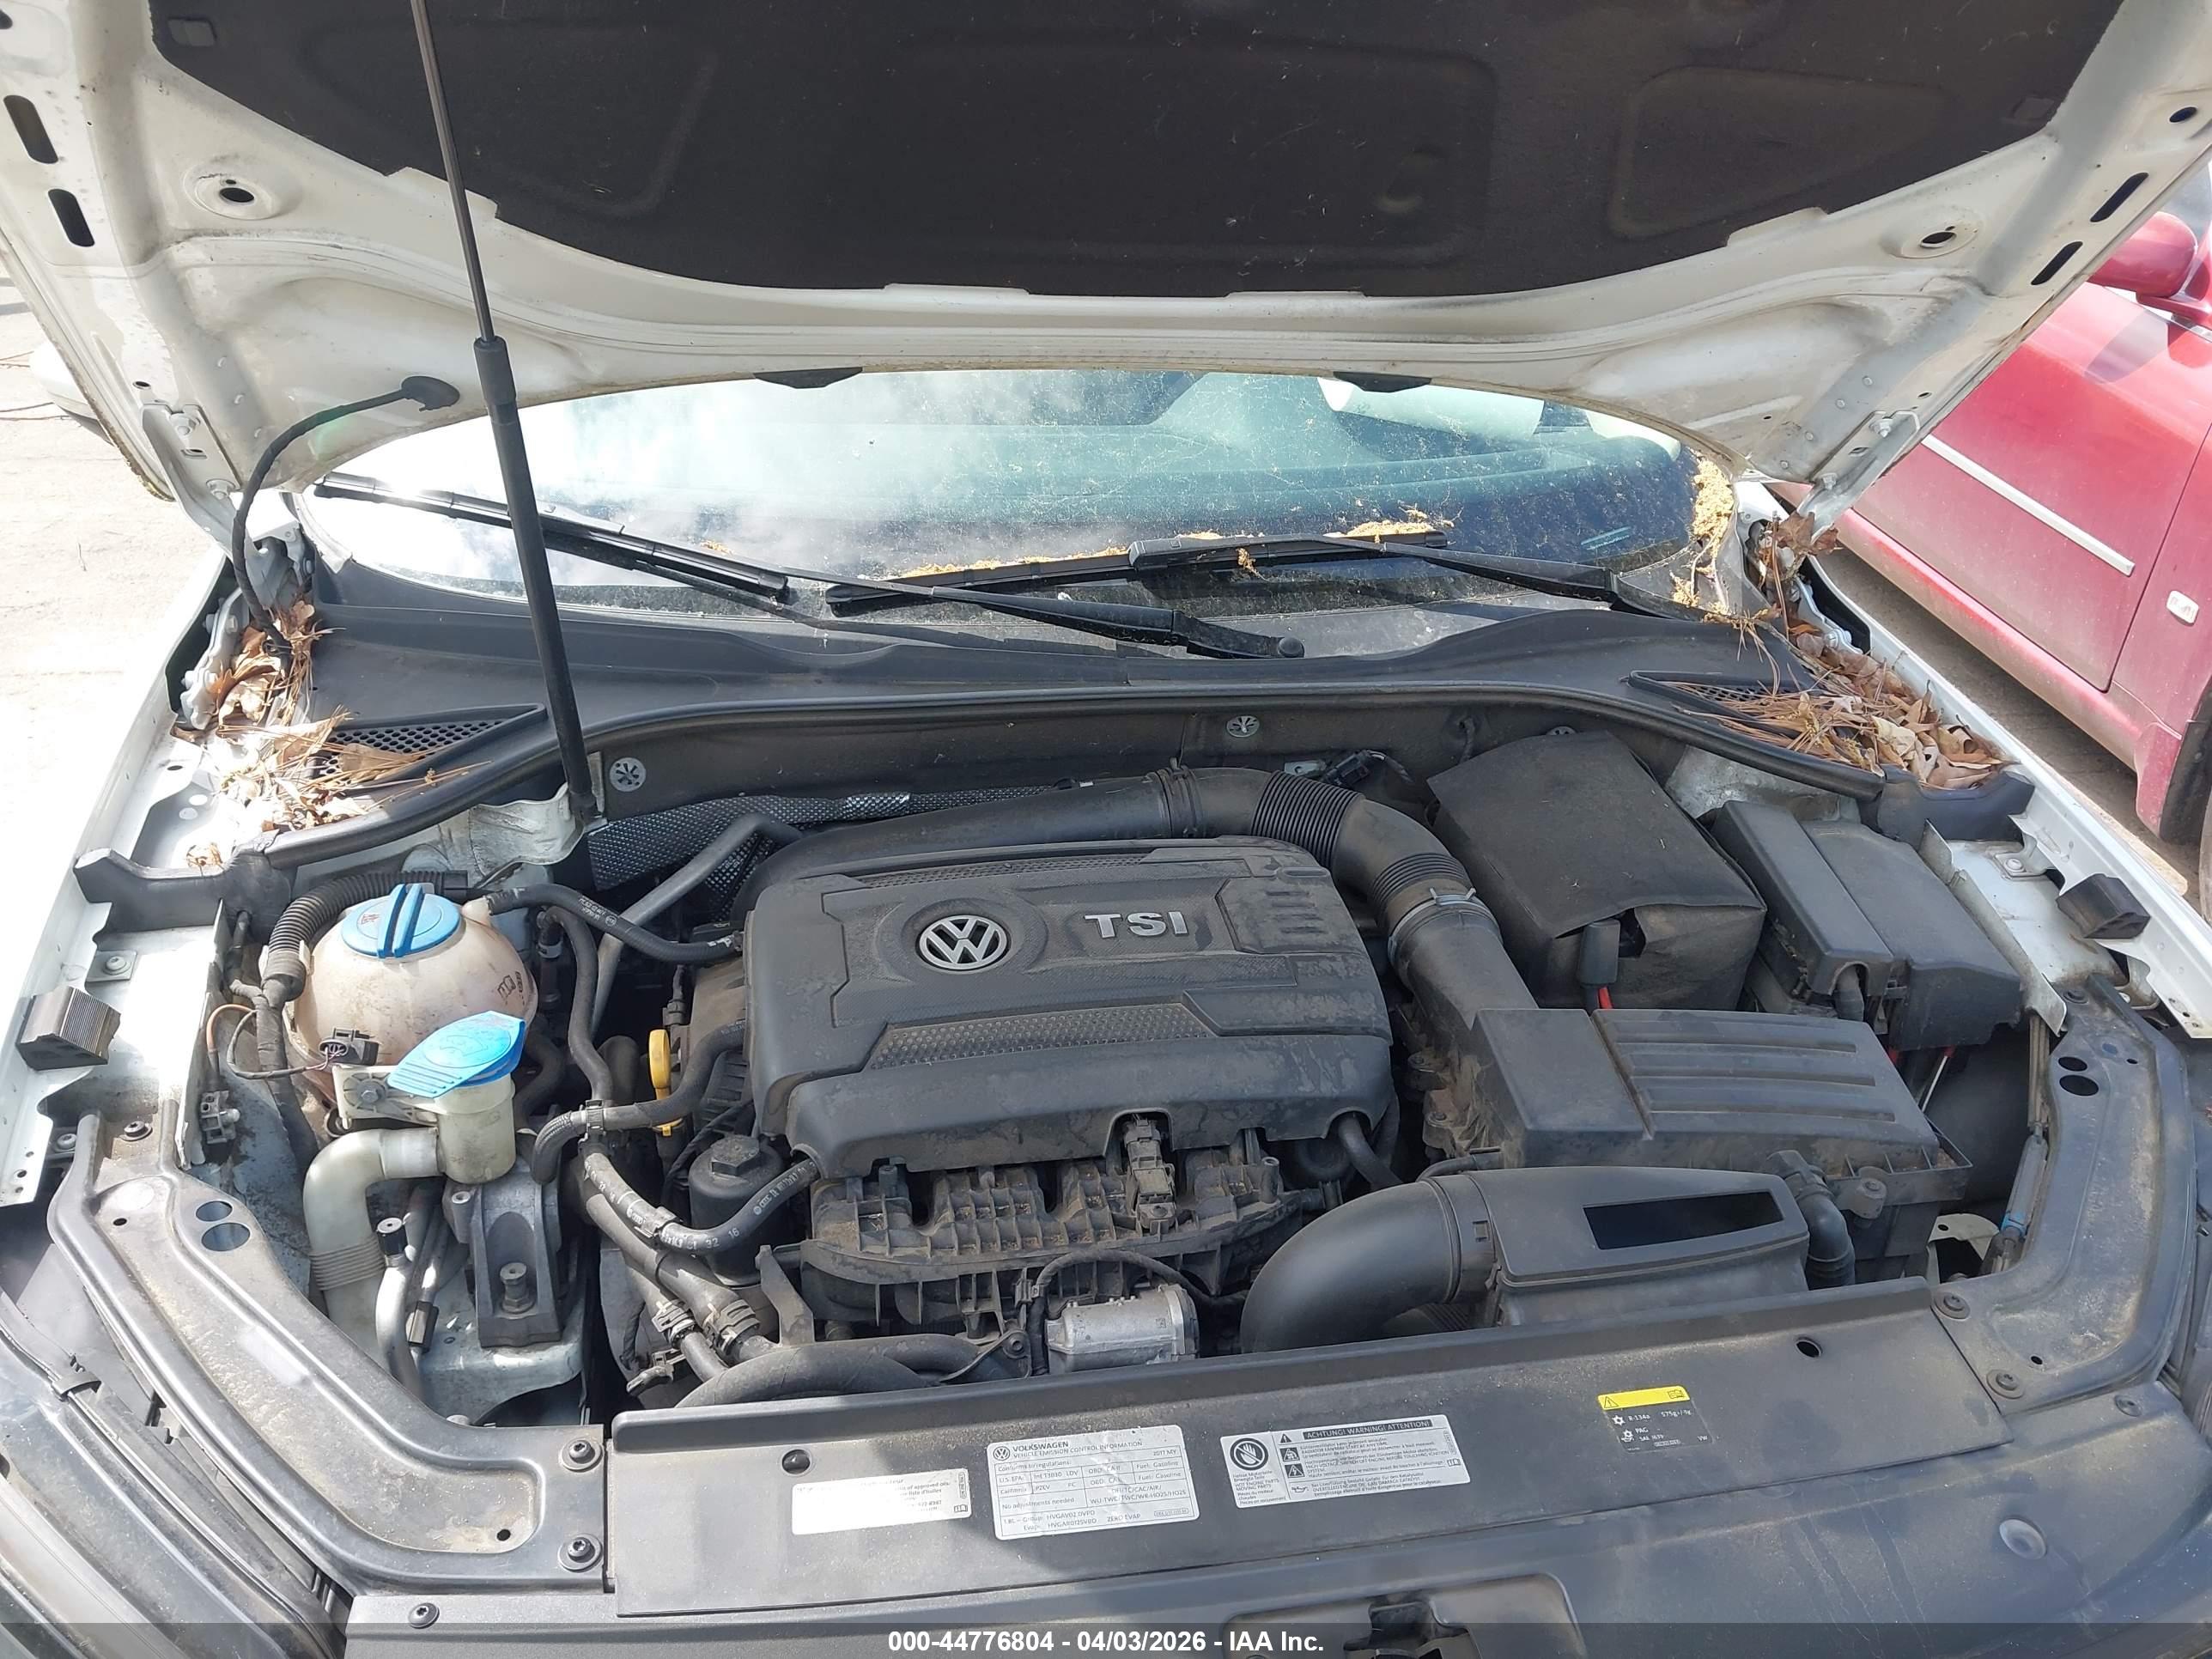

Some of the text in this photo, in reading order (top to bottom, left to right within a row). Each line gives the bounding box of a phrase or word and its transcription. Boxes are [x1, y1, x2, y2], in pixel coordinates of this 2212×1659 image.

[1084, 911, 1188, 939] TSI
[727, 1228, 739, 1239] 16
[1306, 1420, 1430, 1438] ACHTUNG! WARNING! ATTENTION!
[1012, 1440, 1068, 1452] VOLKSWAGEN
[1099, 1441, 1142, 1449] INFORMATION
[1051, 1497, 1074, 1505] needed
